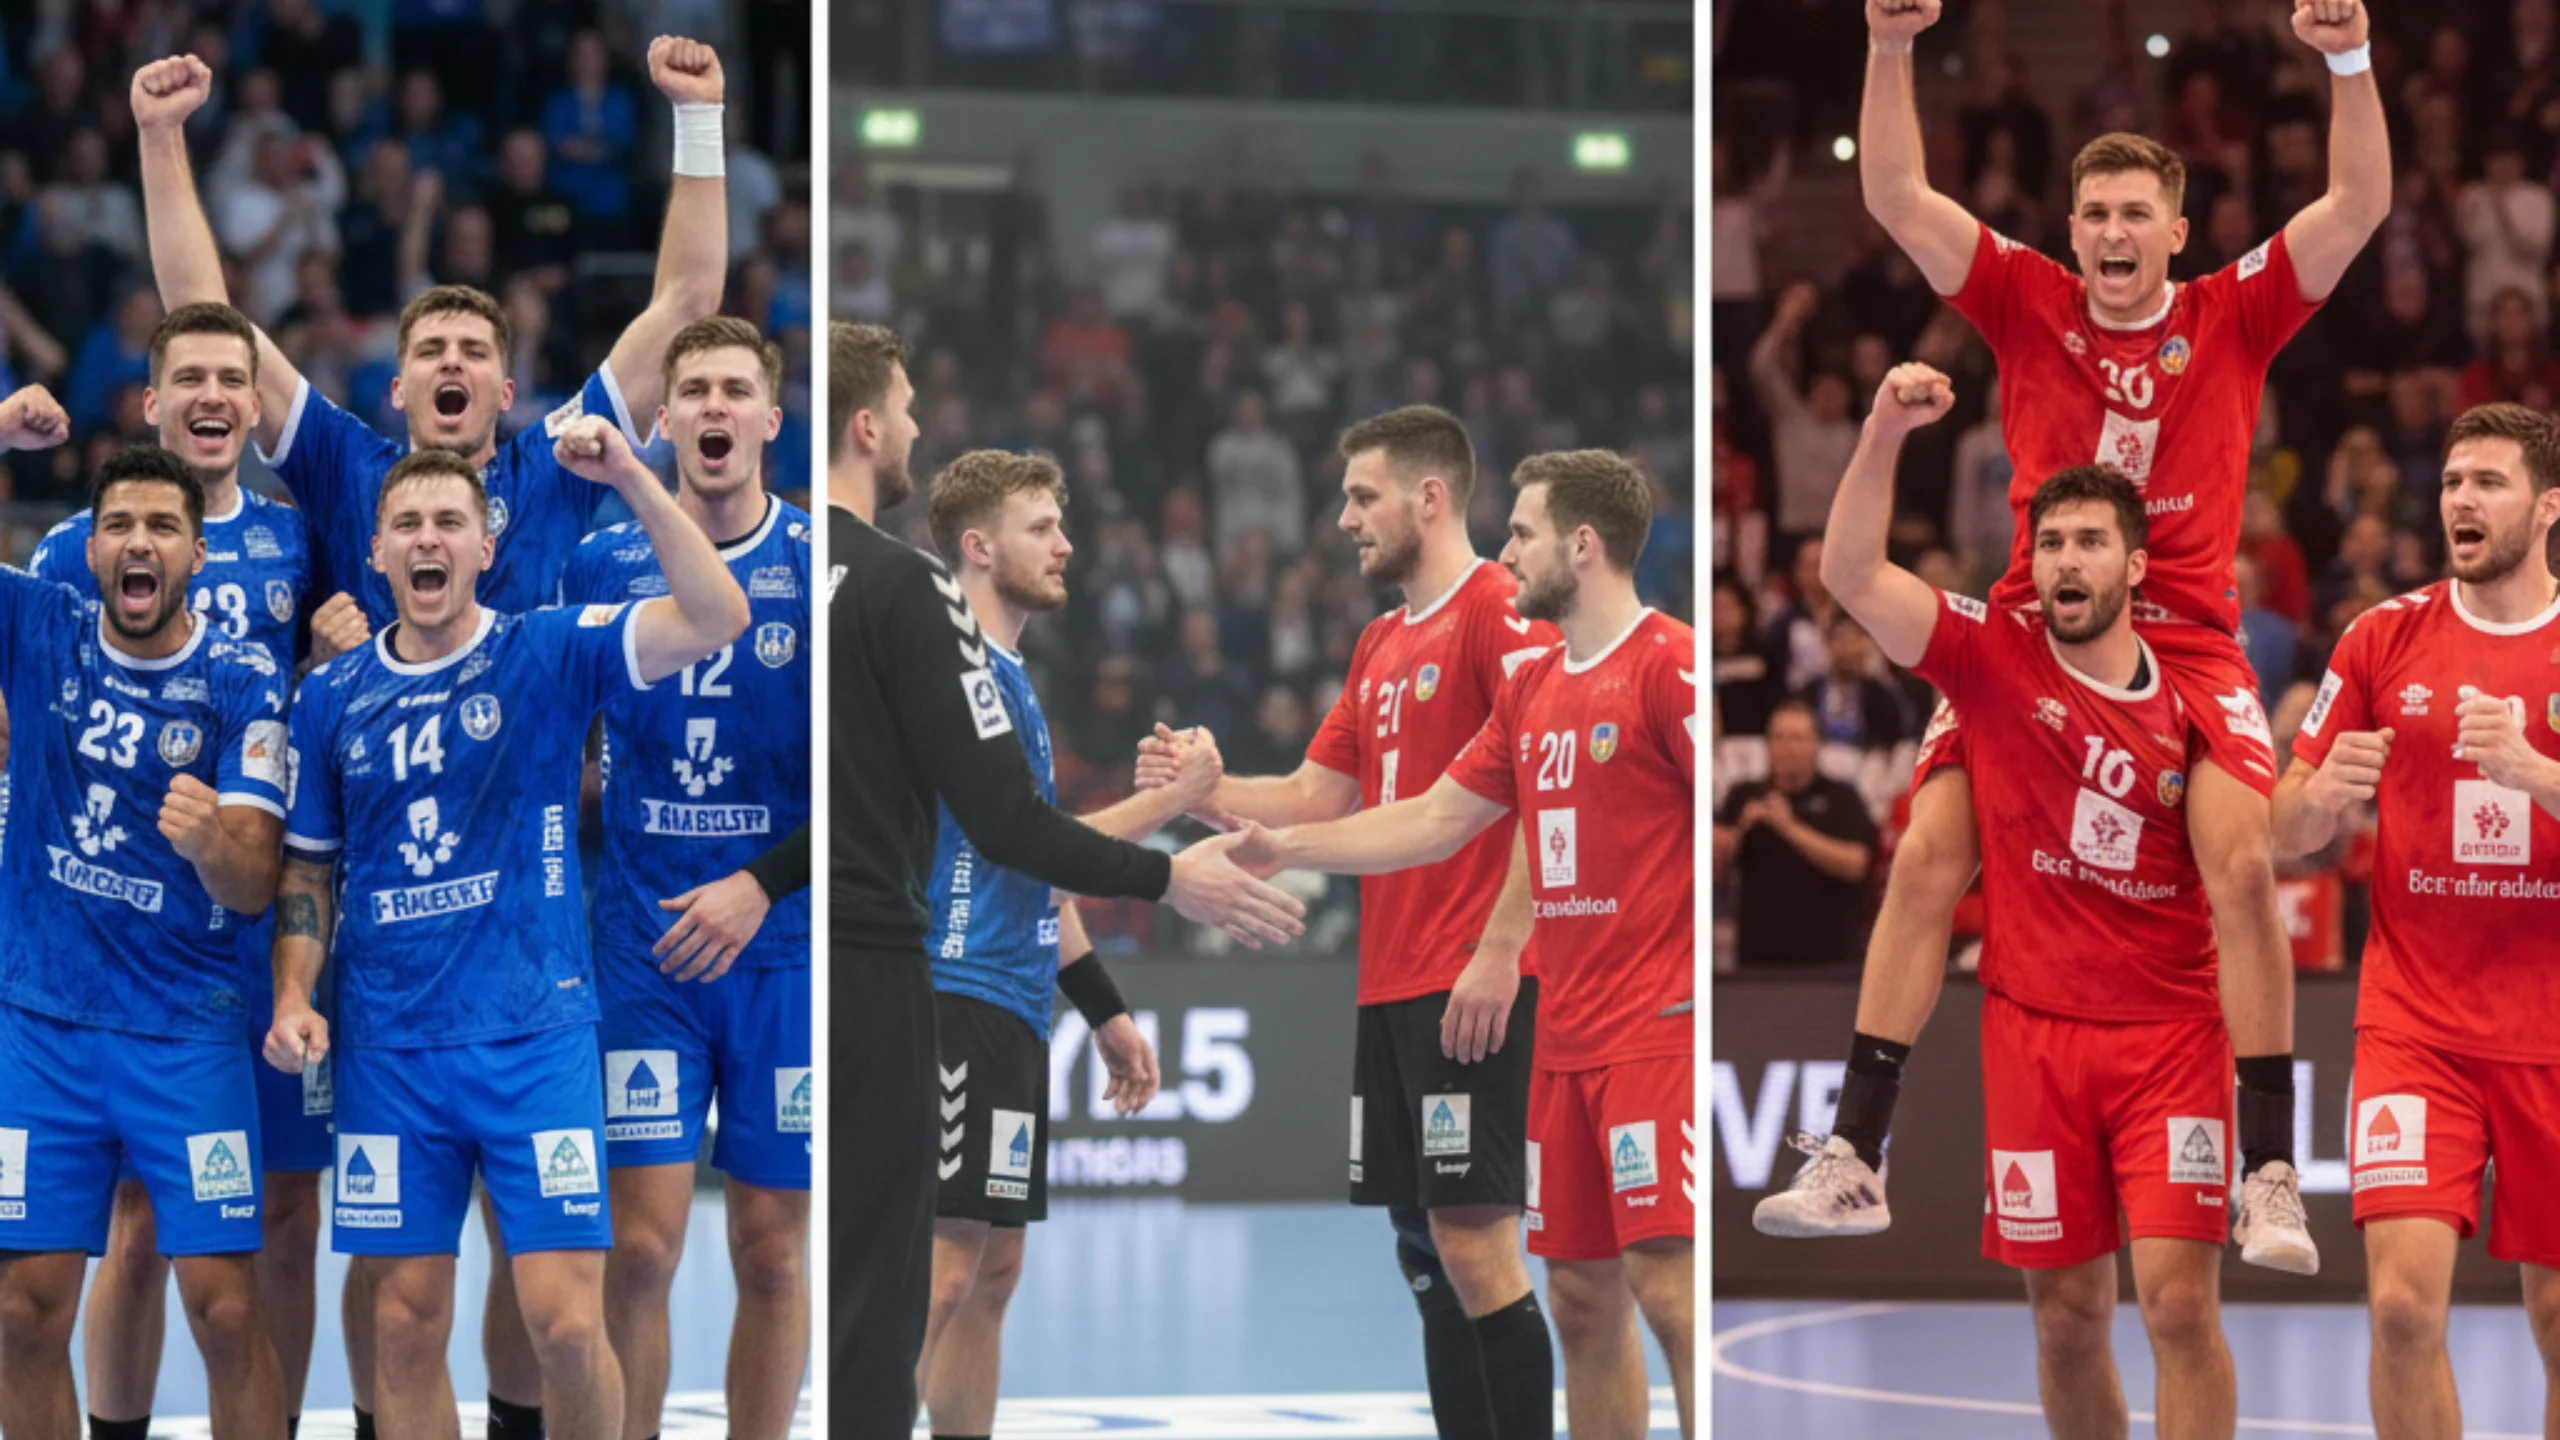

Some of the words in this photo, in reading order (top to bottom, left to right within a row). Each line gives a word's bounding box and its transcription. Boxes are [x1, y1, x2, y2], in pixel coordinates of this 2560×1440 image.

[78, 699, 146, 769] 23
[387, 712, 446, 782] 14
[1537, 729, 1577, 791] 20
